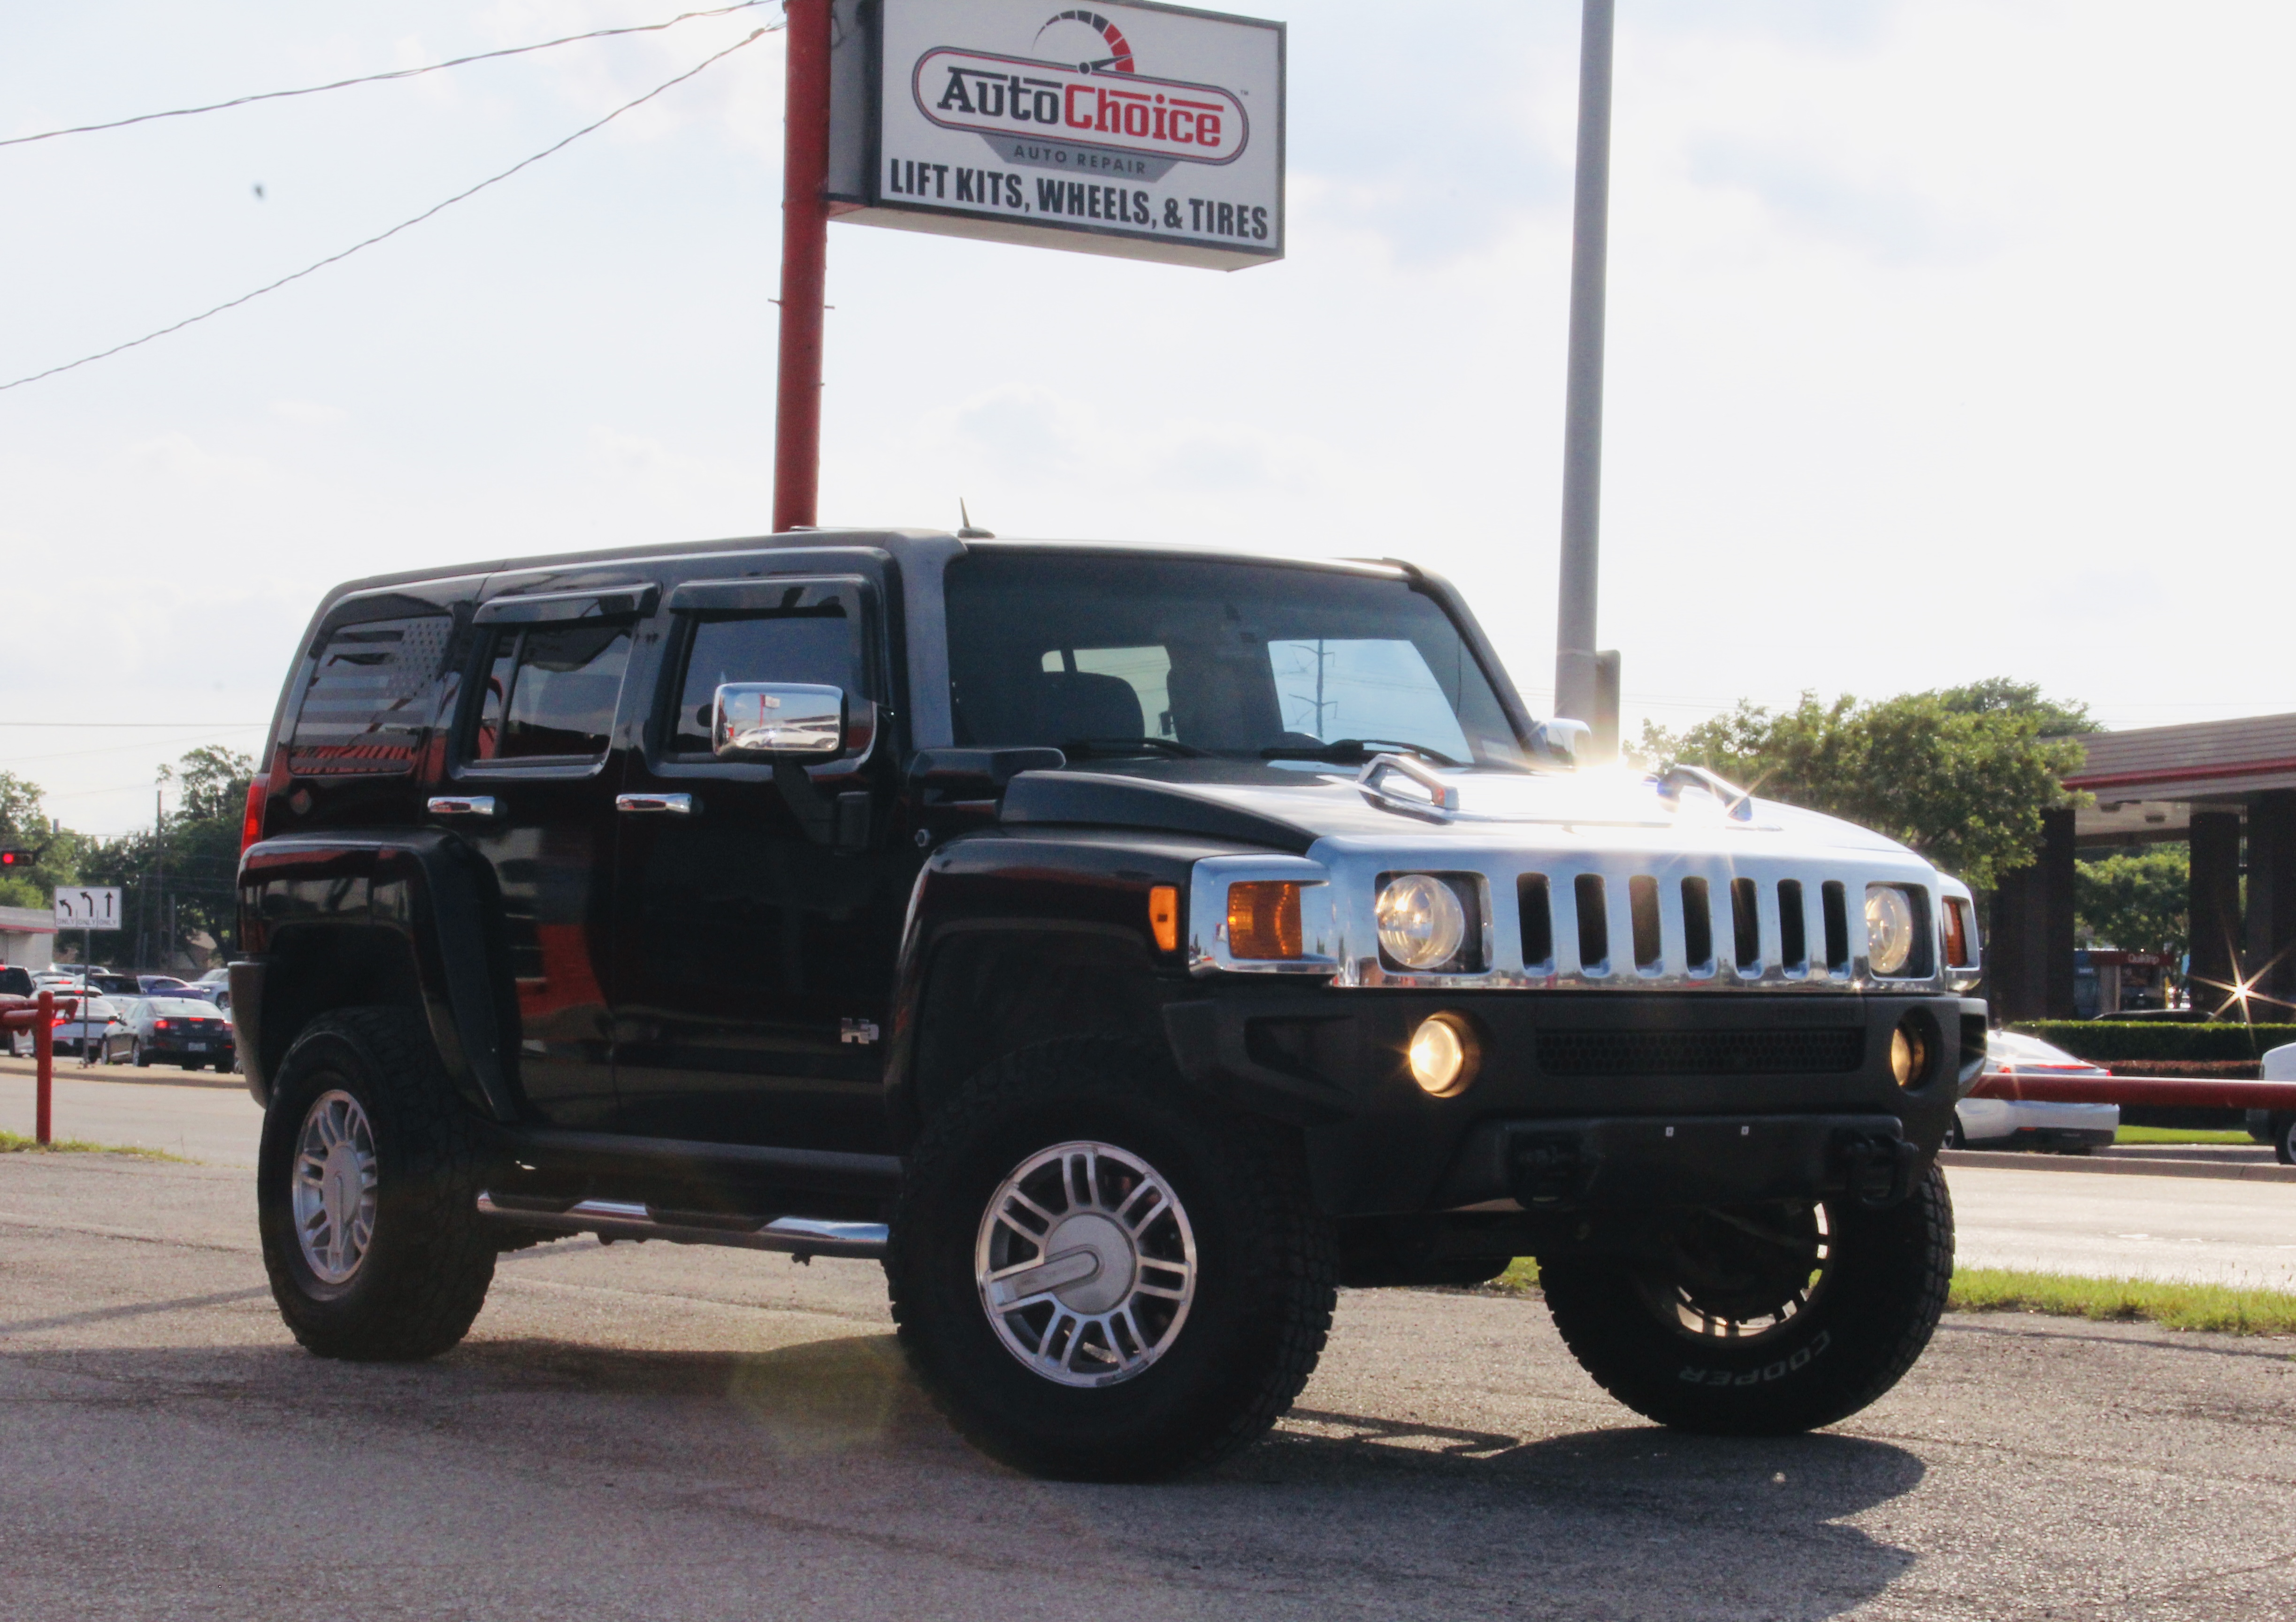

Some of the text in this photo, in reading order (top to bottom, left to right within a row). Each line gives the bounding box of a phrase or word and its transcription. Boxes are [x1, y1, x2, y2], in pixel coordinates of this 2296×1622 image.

[937, 67, 1224, 148] AutoChoice
[1014, 145, 1146, 175] AUTO REPAIR
[891, 158, 1268, 240] LIFT KITS, WHEELS, & TIRES
[1679, 1330, 1831, 1385] COOPER
